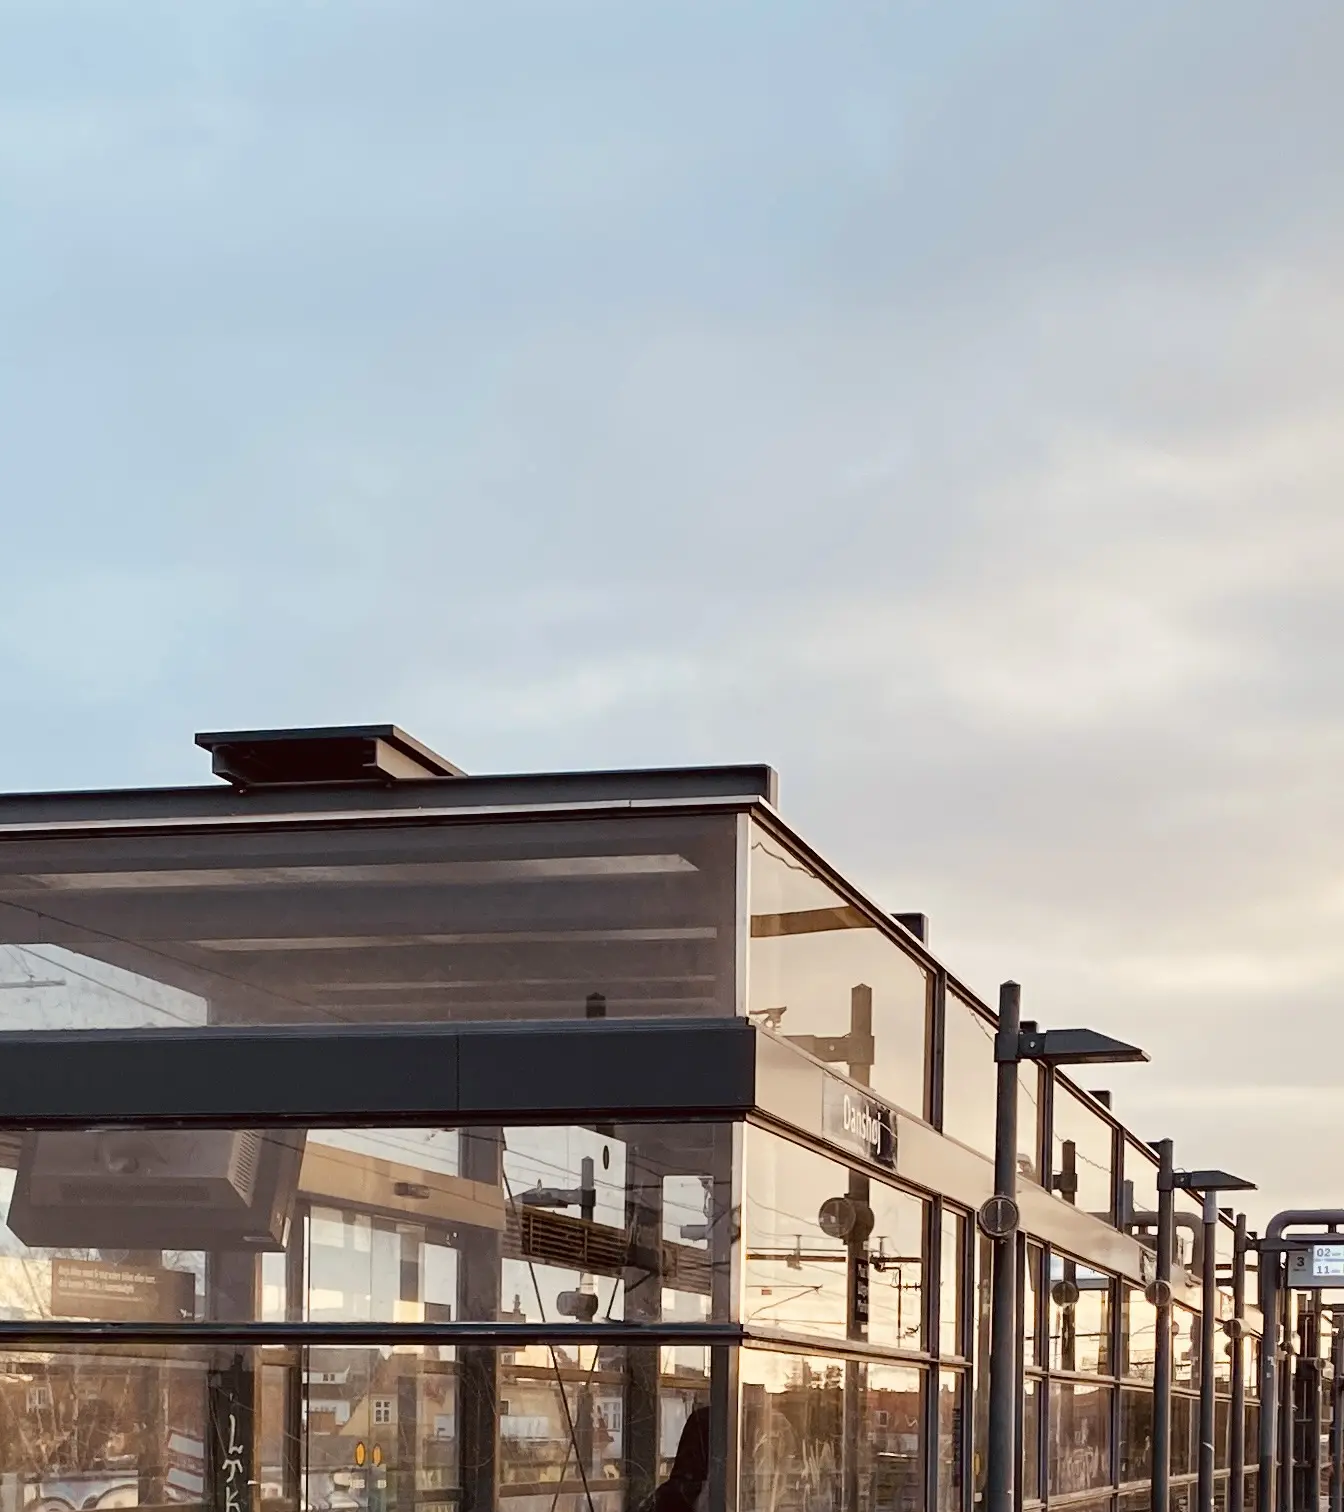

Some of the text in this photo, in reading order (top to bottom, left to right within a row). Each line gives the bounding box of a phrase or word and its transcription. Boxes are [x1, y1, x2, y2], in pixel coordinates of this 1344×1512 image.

[843, 1094, 881, 1155] Danshøj
[1316, 1247, 1331, 1257] 02
[1296, 1256, 1305, 1267] 3
[1316, 1265, 1330, 1274] 11
